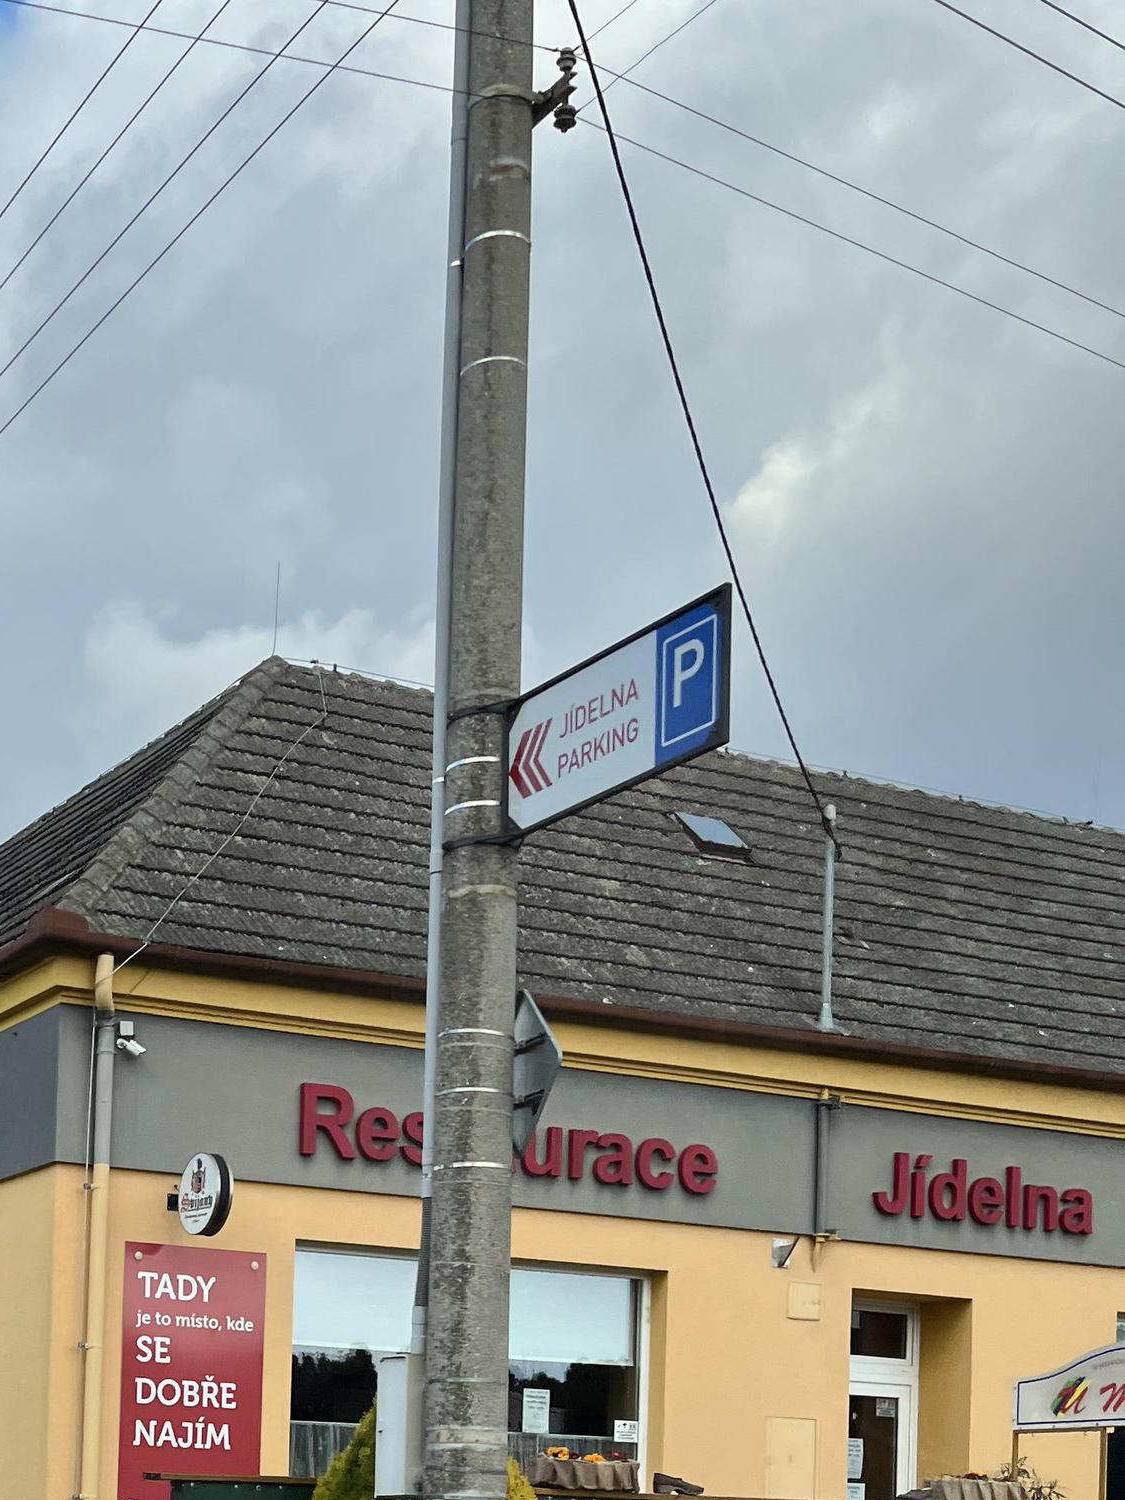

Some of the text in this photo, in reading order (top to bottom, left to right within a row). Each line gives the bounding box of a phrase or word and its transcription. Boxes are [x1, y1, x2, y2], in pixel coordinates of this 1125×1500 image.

[672, 638, 706, 709] P
[559, 678, 639, 740] JÍDELNA
[557, 717, 639, 779] PARKING
[298, 1081, 719, 1195] Resurace
[871, 1151, 1094, 1236] Jídelna
[137, 1271, 217, 1304] TADY
[135, 1311, 254, 1333] je to místo, kde
[135, 1335, 172, 1364] SE
[134, 1374, 238, 1410] DOBŘE
[132, 1416, 231, 1451] NAJÍM
